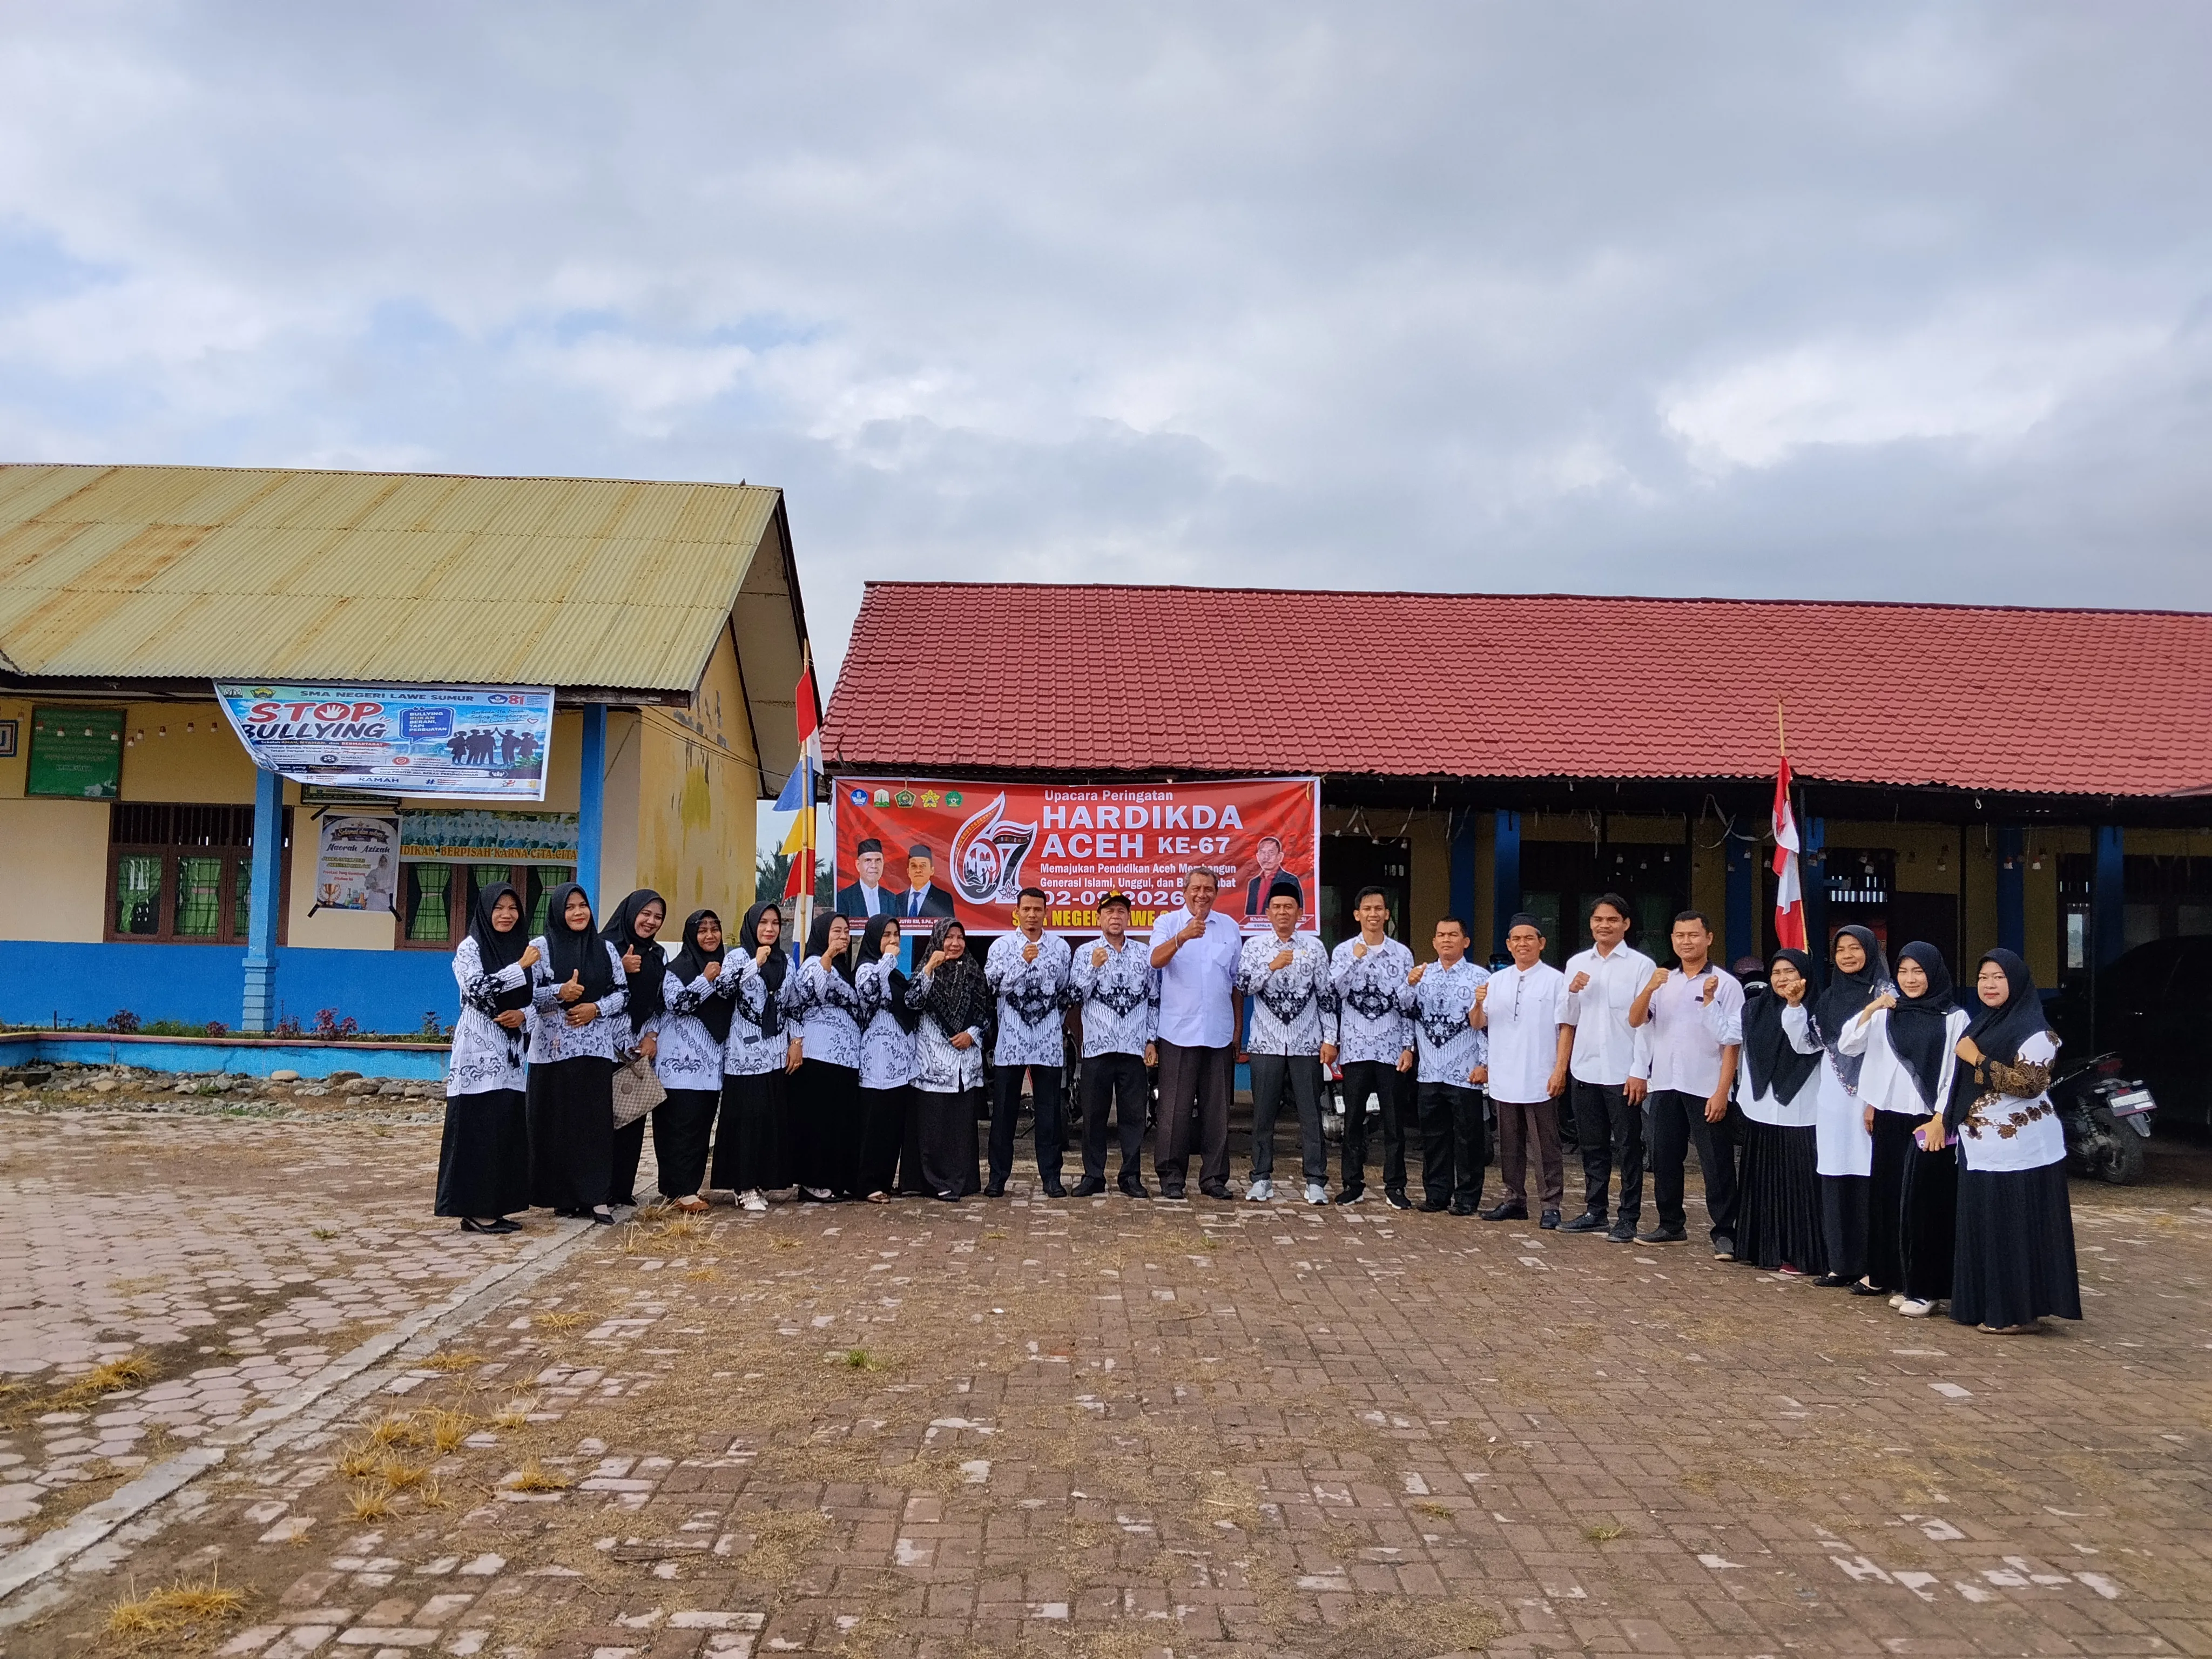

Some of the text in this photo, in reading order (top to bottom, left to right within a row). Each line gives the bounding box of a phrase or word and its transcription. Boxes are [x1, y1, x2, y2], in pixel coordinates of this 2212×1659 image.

[508, 694, 525, 705] 81
[247, 702, 383, 723] STOP
[241, 723, 387, 739] BULLYING
[1044, 790, 1174, 803] Upacara Peringatan
[1043, 805, 1243, 830] HARDIKDA
[360, 845, 391, 853] Azizah
[441, 846, 491, 858] BERPISAH
[494, 847, 528, 858] KARNA
[1041, 834, 1230, 858] ACEH KE-67
[1040, 863, 1095, 875] Memajukan
[1098, 863, 1150, 873] Pendidikan
[1152, 863, 1176, 873] Aceh
[1040, 877, 1081, 887] Generasi
[1084, 877, 1115, 889] Islami,
[1118, 877, 1154, 889] Unggul,
[1156, 877, 1174, 887] dan
[1044, 891, 1185, 906] 02-02026
[1052, 910, 1101, 926] NEGER
